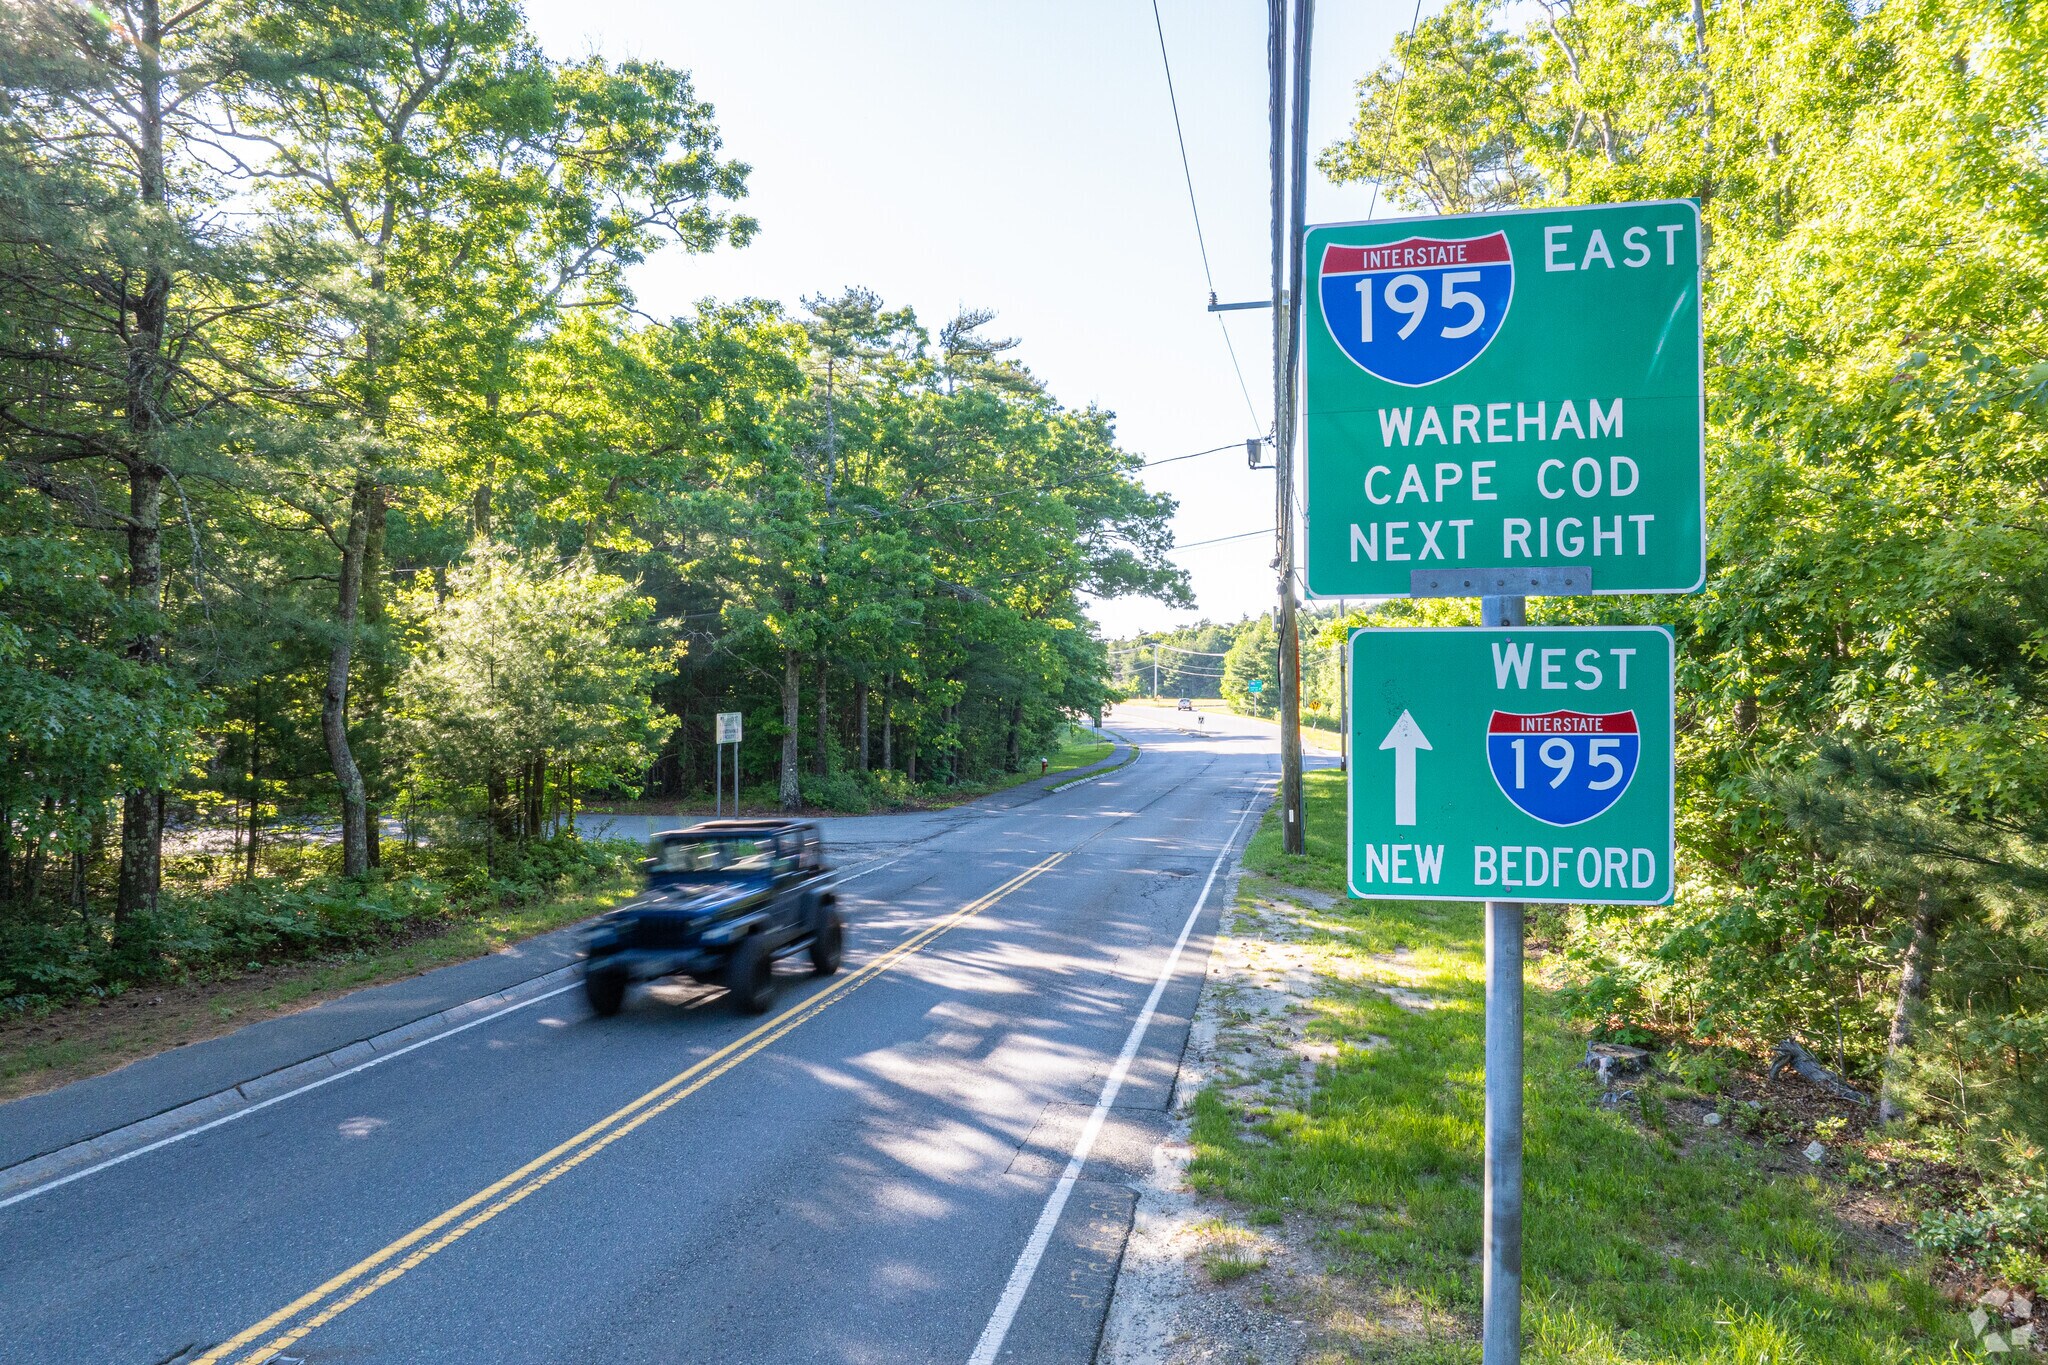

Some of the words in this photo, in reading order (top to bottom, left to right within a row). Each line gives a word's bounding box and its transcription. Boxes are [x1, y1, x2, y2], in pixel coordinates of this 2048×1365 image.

[1363, 244, 1467, 268] INTERSTATE
[1544, 225, 1683, 272] EAST
[1355, 271, 1485, 342] 195
[1379, 398, 1623, 447] WAREHAM
[1365, 461, 1497, 504] CAPE
[1537, 456, 1639, 500] COD
[1351, 519, 1473, 562] NEXT
[1504, 515, 1654, 558] RIGHT
[1492, 643, 1636, 690] WEST
[1521, 718, 1603, 732] INTERSTATE
[1511, 738, 1624, 791] 195
[1366, 844, 1445, 884] NEW
[1474, 846, 1656, 888] BEDFORD
